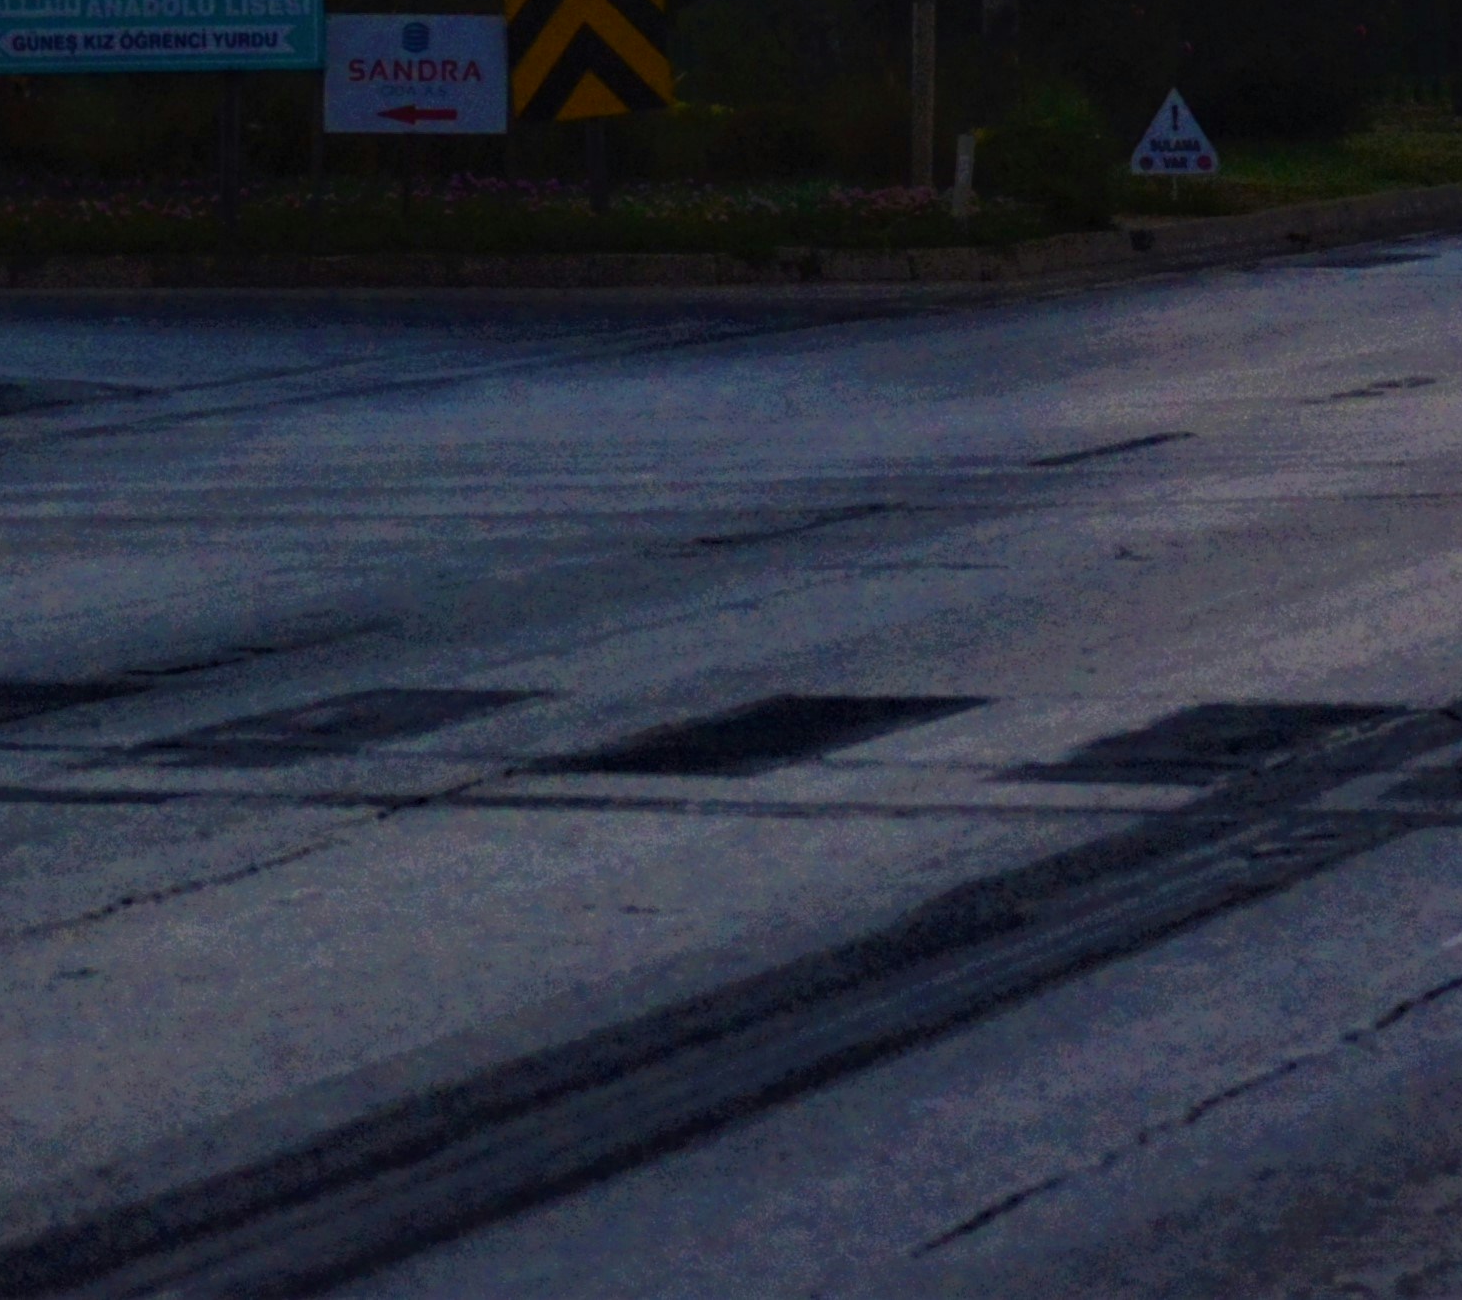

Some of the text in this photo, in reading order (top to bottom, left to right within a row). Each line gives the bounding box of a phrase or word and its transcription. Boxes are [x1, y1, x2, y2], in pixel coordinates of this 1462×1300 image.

[12, 29, 278, 55] GÜNEŞ KIZ ÖĞRENCİ YURDU
[349, 59, 481, 82] SANDRA
